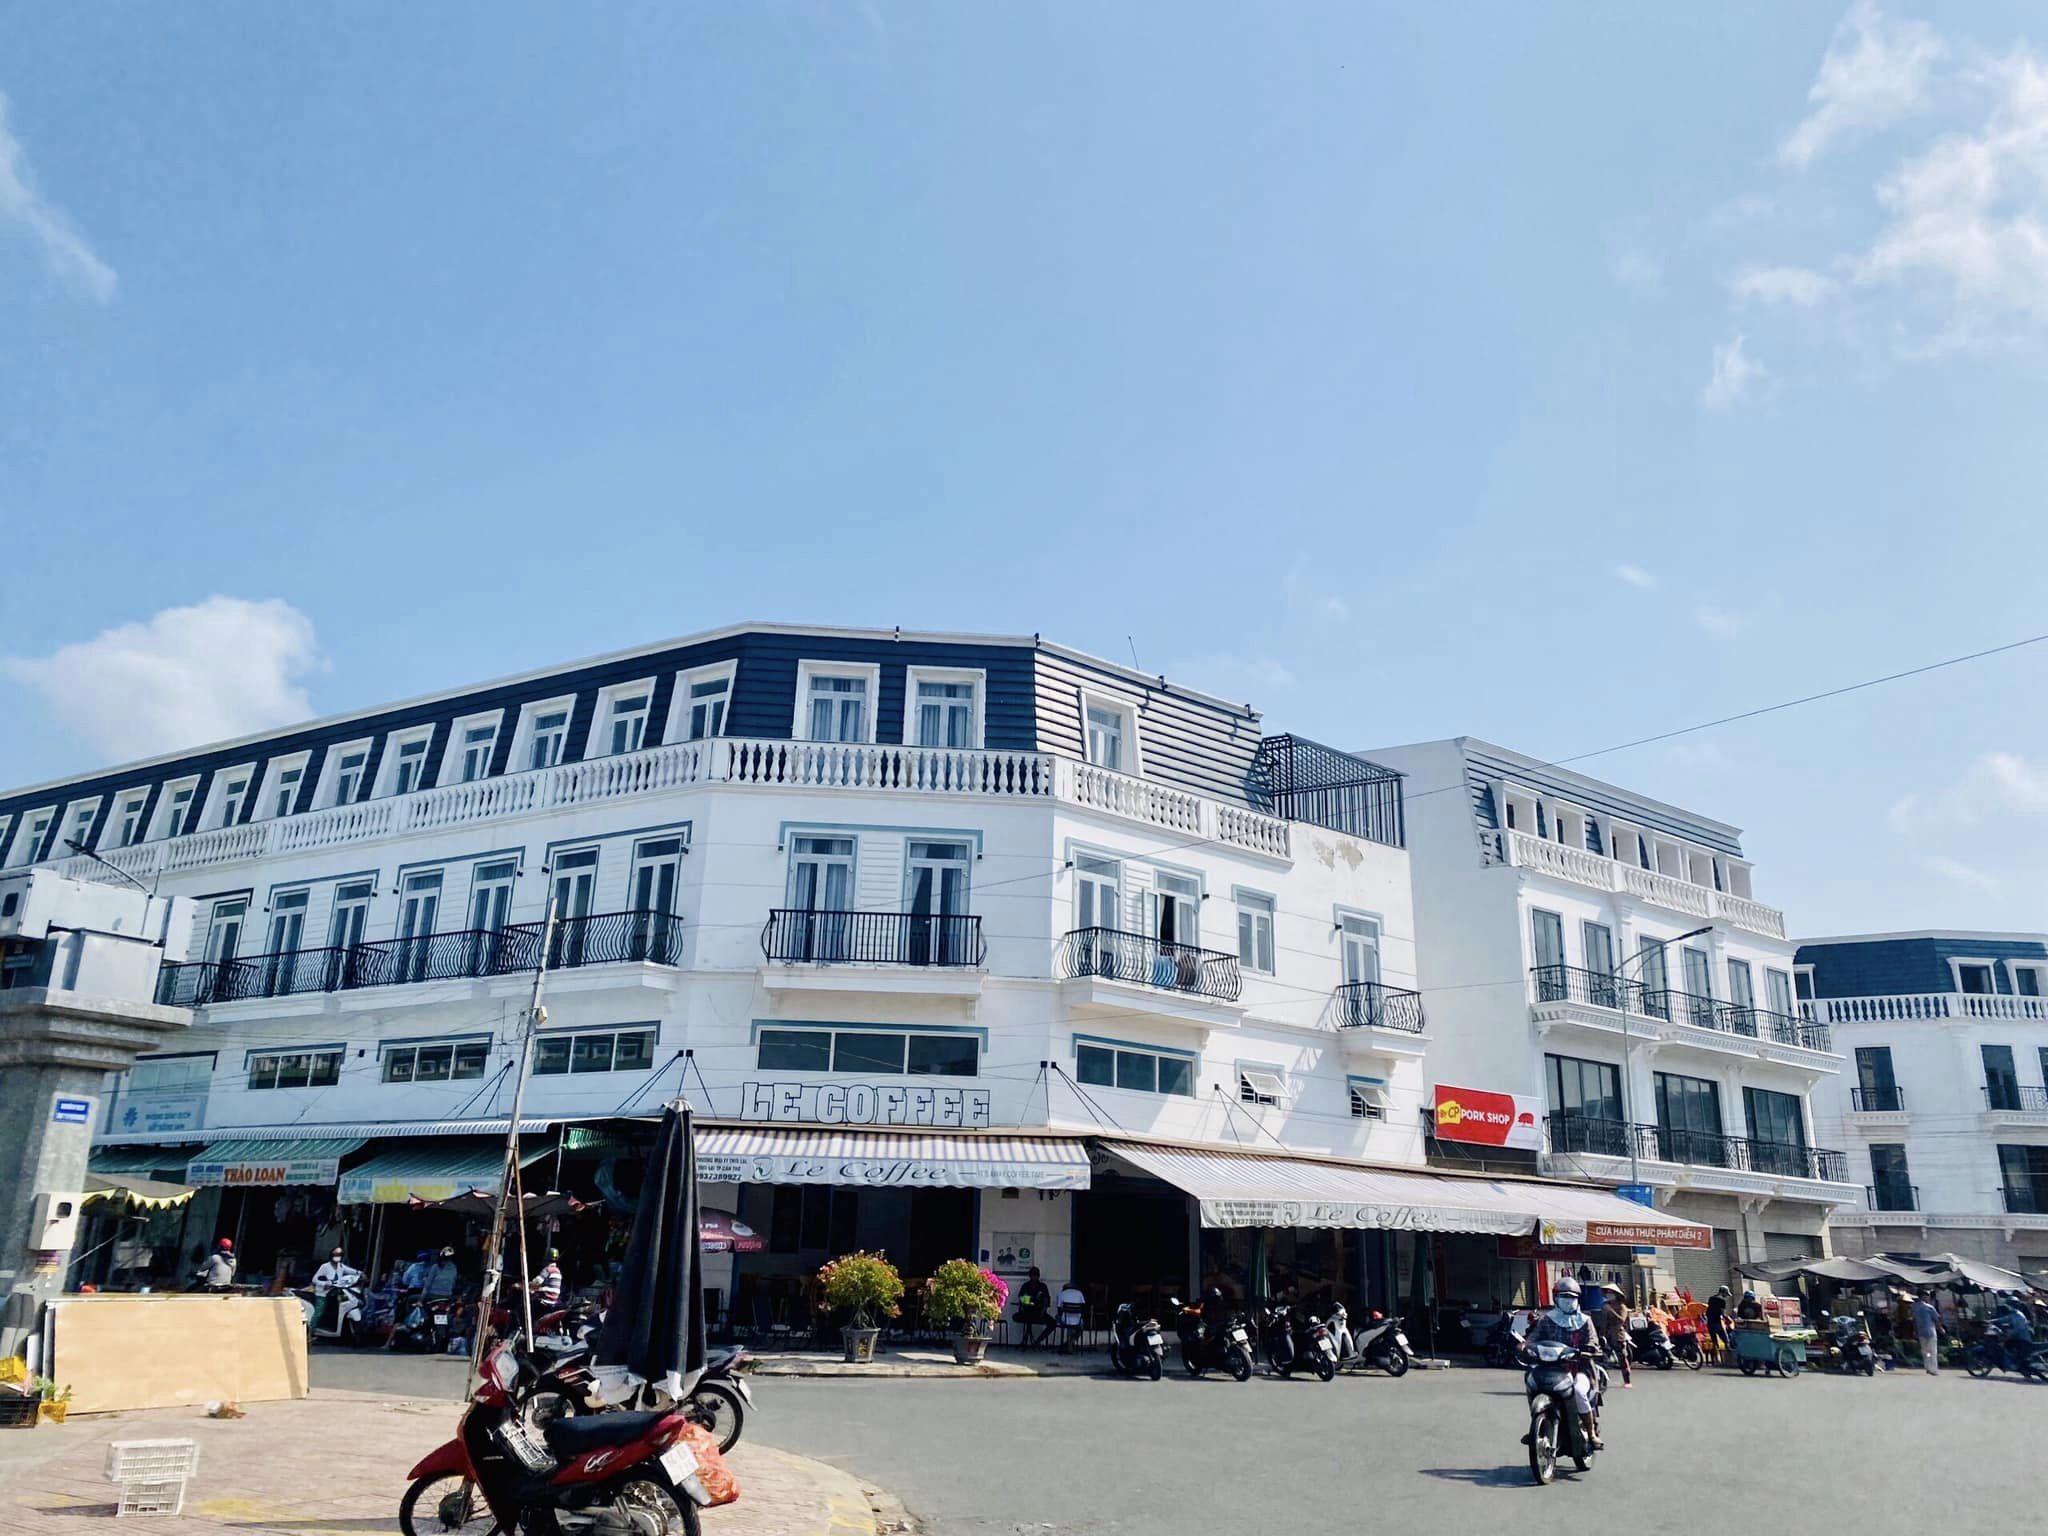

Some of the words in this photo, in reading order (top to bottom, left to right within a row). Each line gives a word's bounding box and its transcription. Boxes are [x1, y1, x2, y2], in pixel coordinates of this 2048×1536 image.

[740, 1082, 802, 1122] LE
[815, 1084, 990, 1128] COFFEE
[1461, 1109, 1486, 1122] PORK
[1487, 1112, 1510, 1125] SHOP
[224, 1163, 252, 1182] THẢO
[254, 1167, 286, 1182] LOAN
[782, 1160, 824, 1177] Le
[840, 1160, 947, 1183] Coffee
[1307, 1205, 1343, 1221] Le
[1356, 1206, 1439, 1228] Coffee
